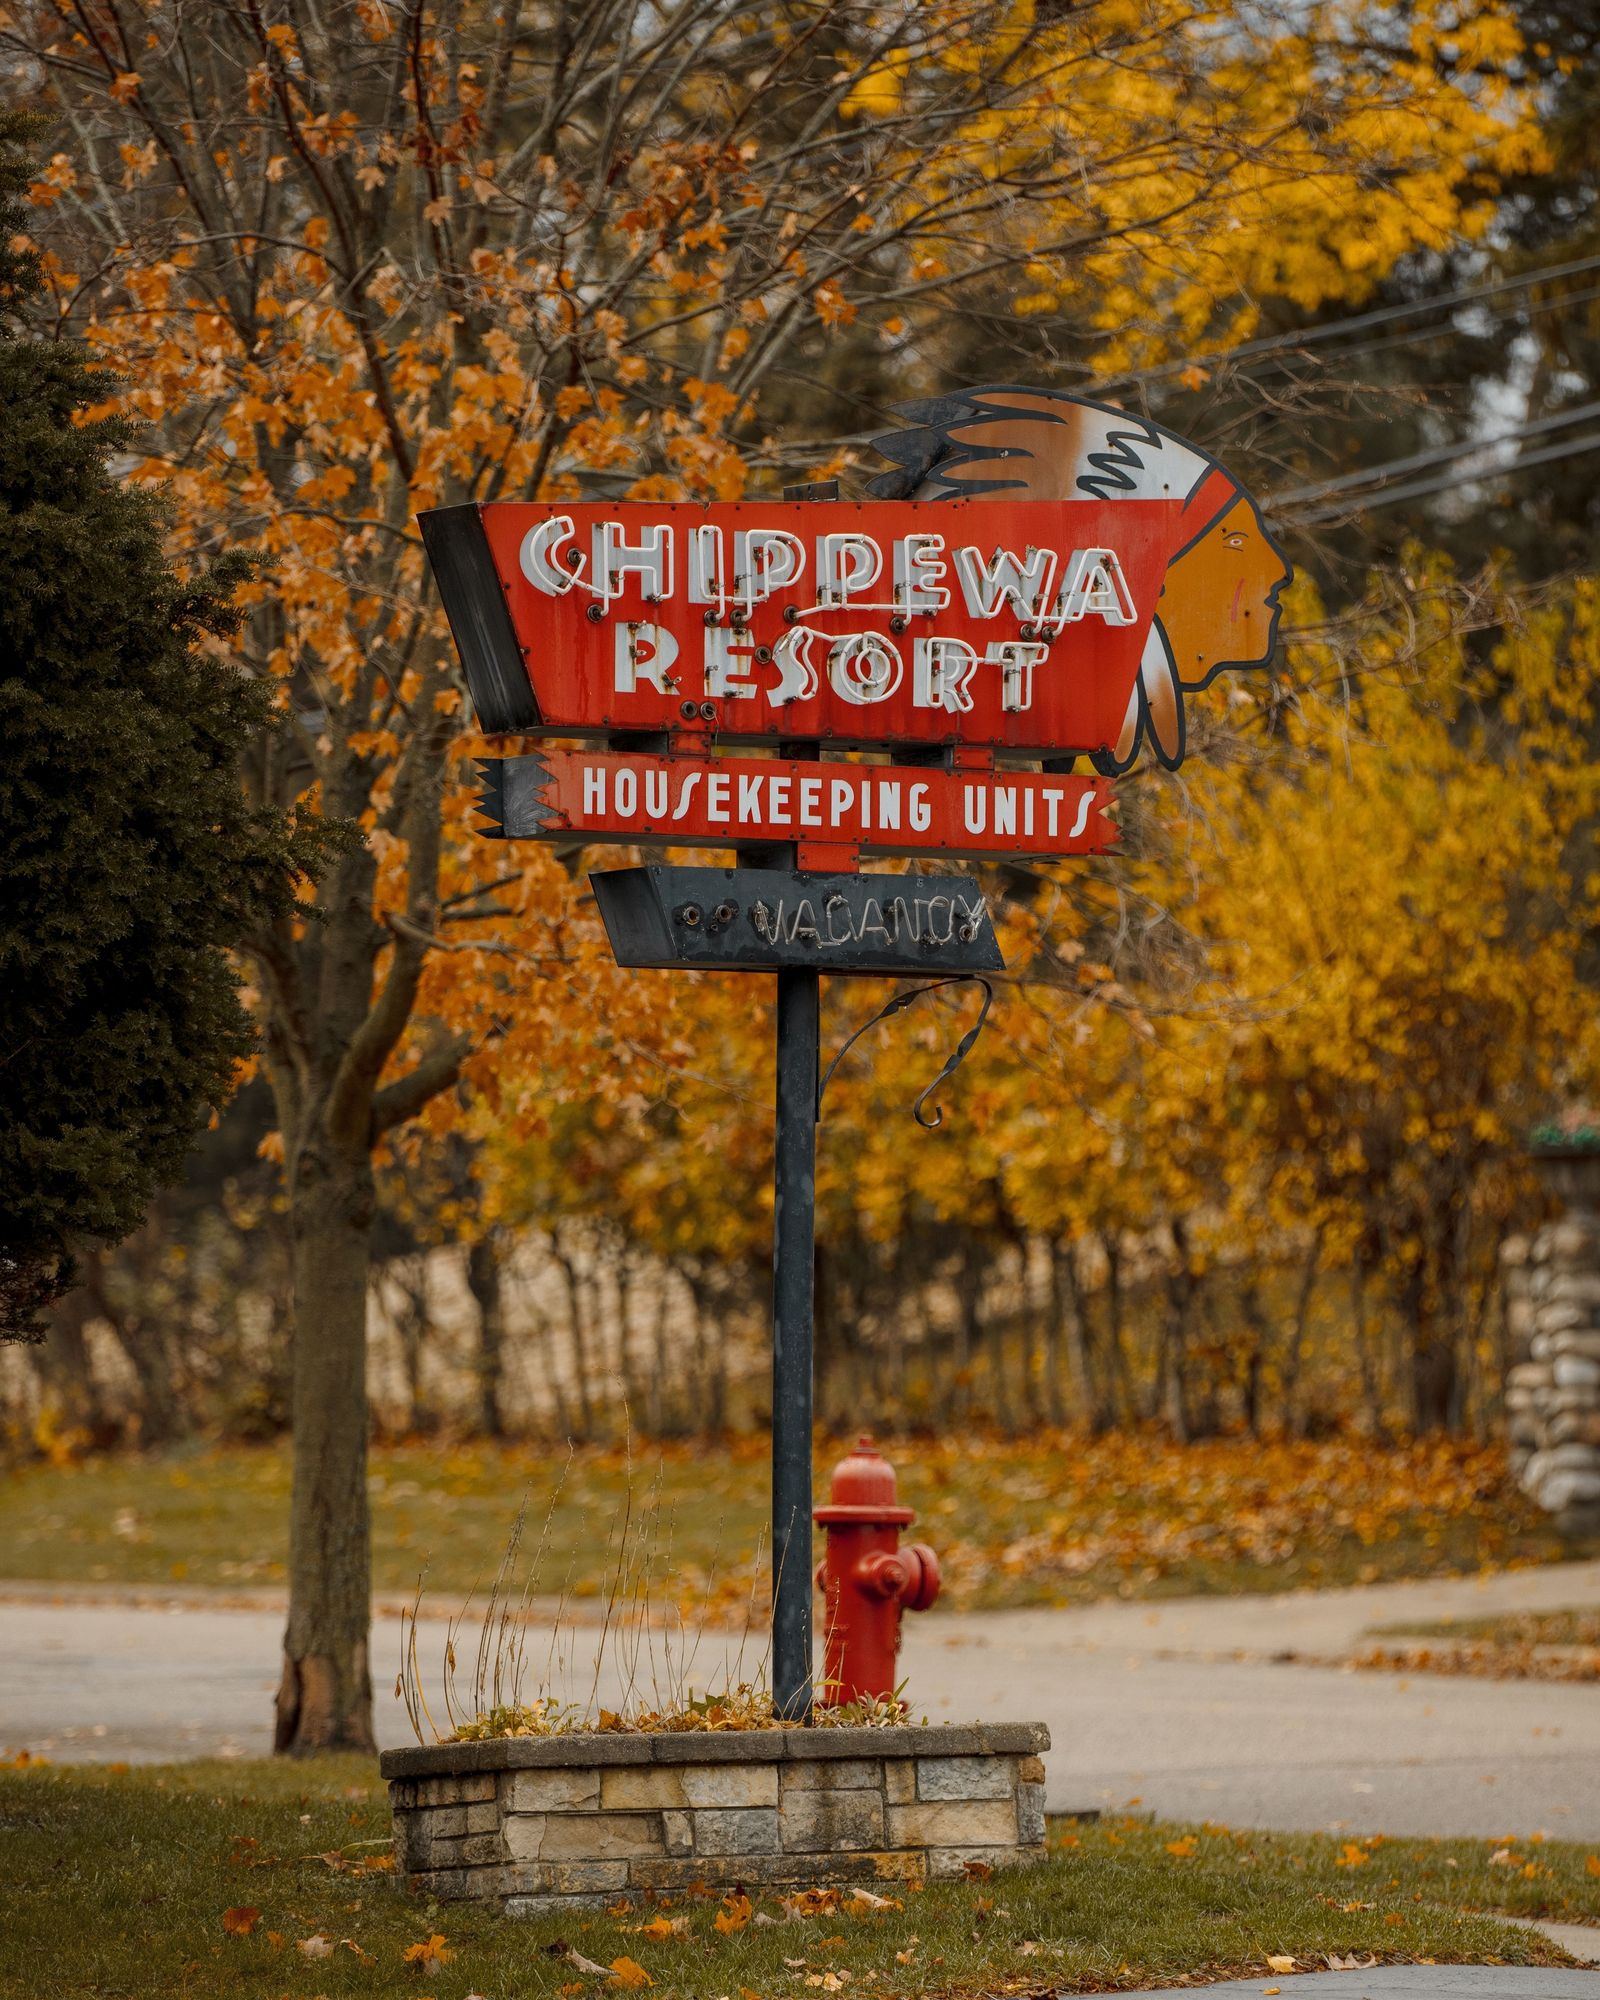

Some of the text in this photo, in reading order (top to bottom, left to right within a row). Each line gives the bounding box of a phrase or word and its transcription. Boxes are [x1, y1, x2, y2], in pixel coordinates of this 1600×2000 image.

[519, 514, 1138, 627] CHIPPEWA
[614, 622, 1050, 714] RESORT
[582, 766, 1096, 838] HOUSEKEEPING UNITS
[752, 894, 987, 947] VACANCY
